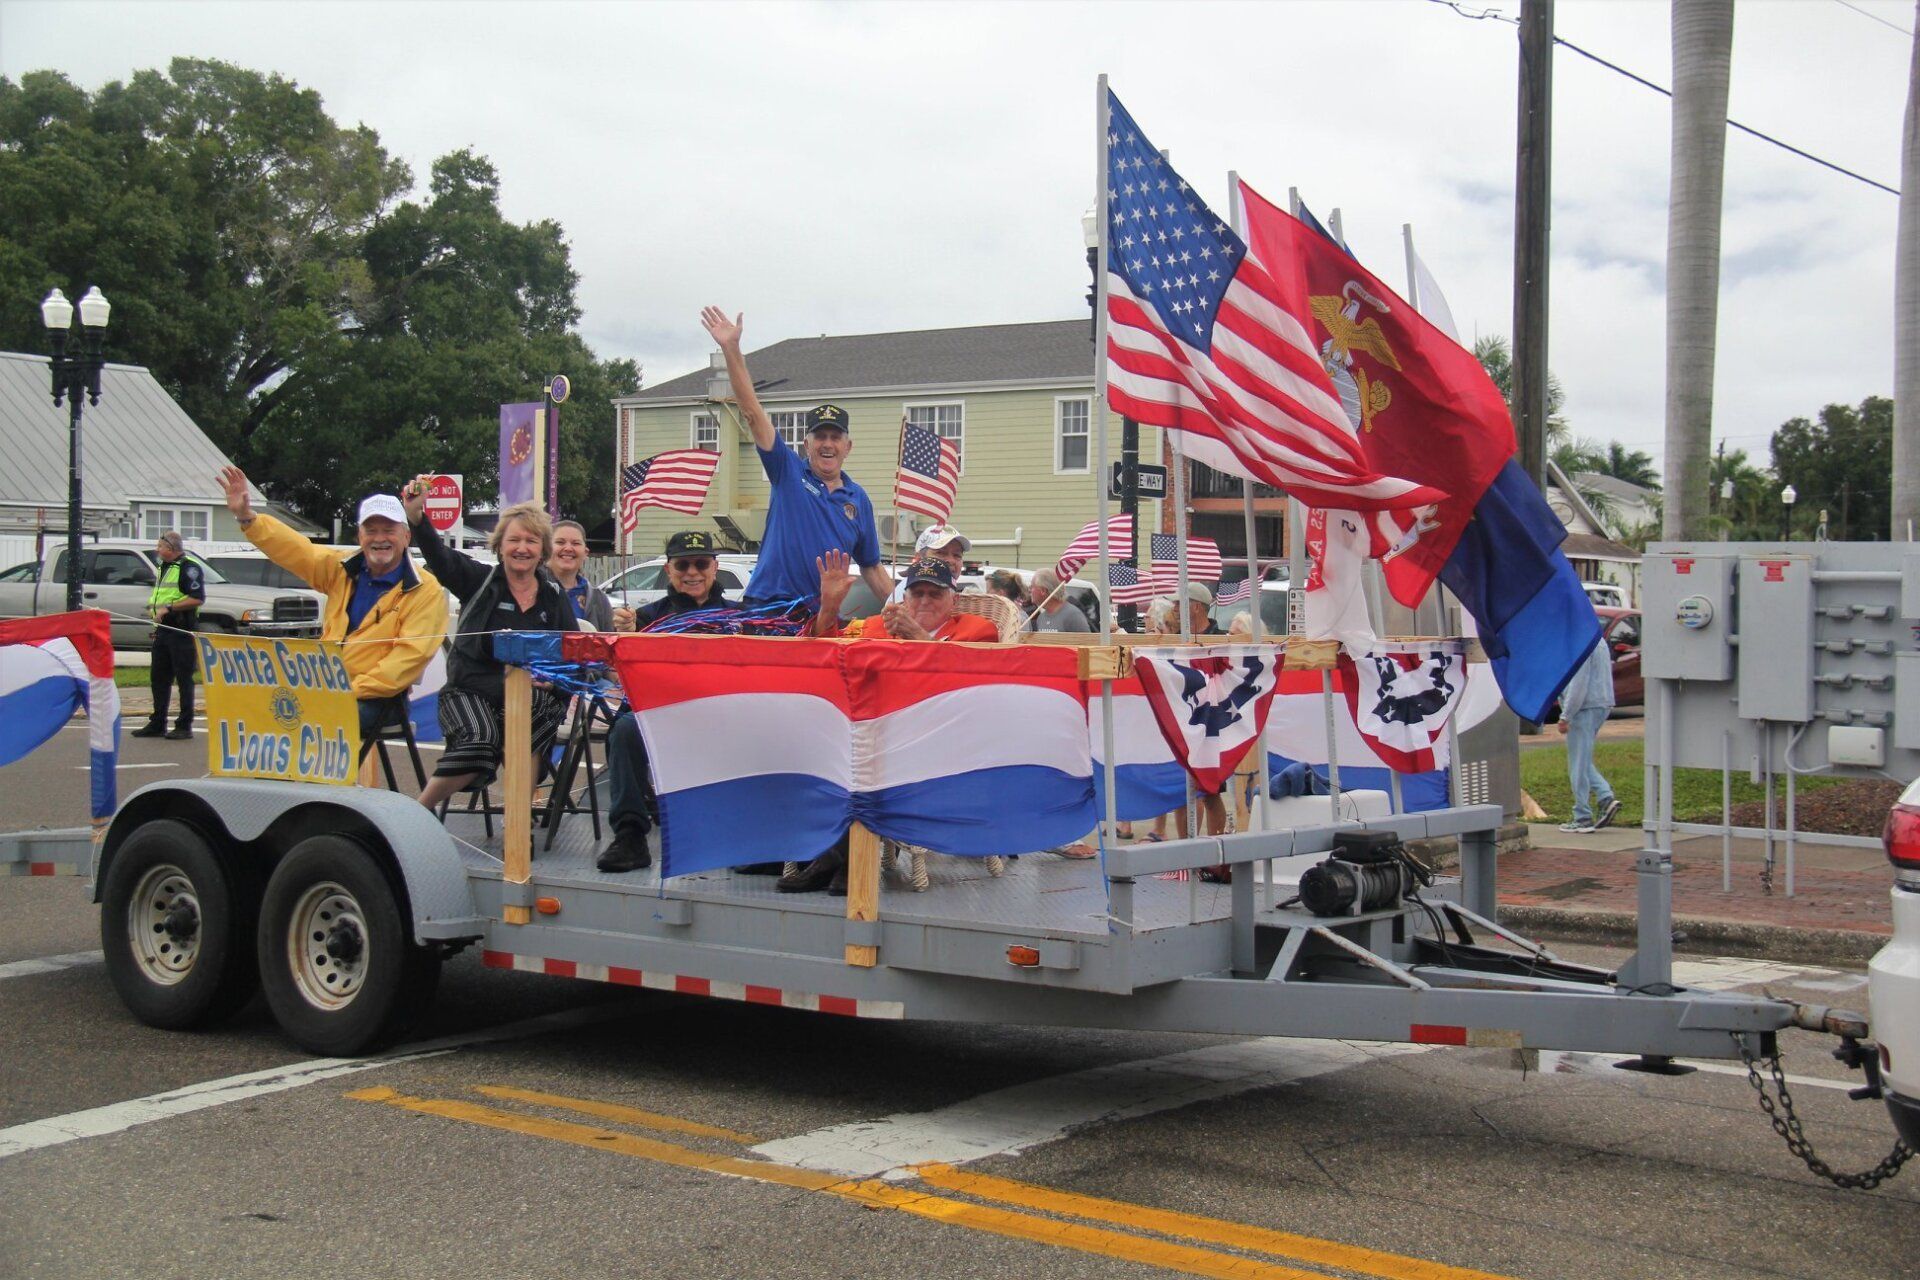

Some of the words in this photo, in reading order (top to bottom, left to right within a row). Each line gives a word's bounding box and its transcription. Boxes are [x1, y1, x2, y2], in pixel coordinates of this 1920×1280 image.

[1146, 475, 1161, 488] WAY
[442, 486, 457, 495] NOT
[431, 510, 453, 520] ENTER
[200, 637, 277, 685] Punta
[275, 641, 352, 690] Gorda
[221, 721, 291, 773] Lions
[299, 725, 350, 780] Club
